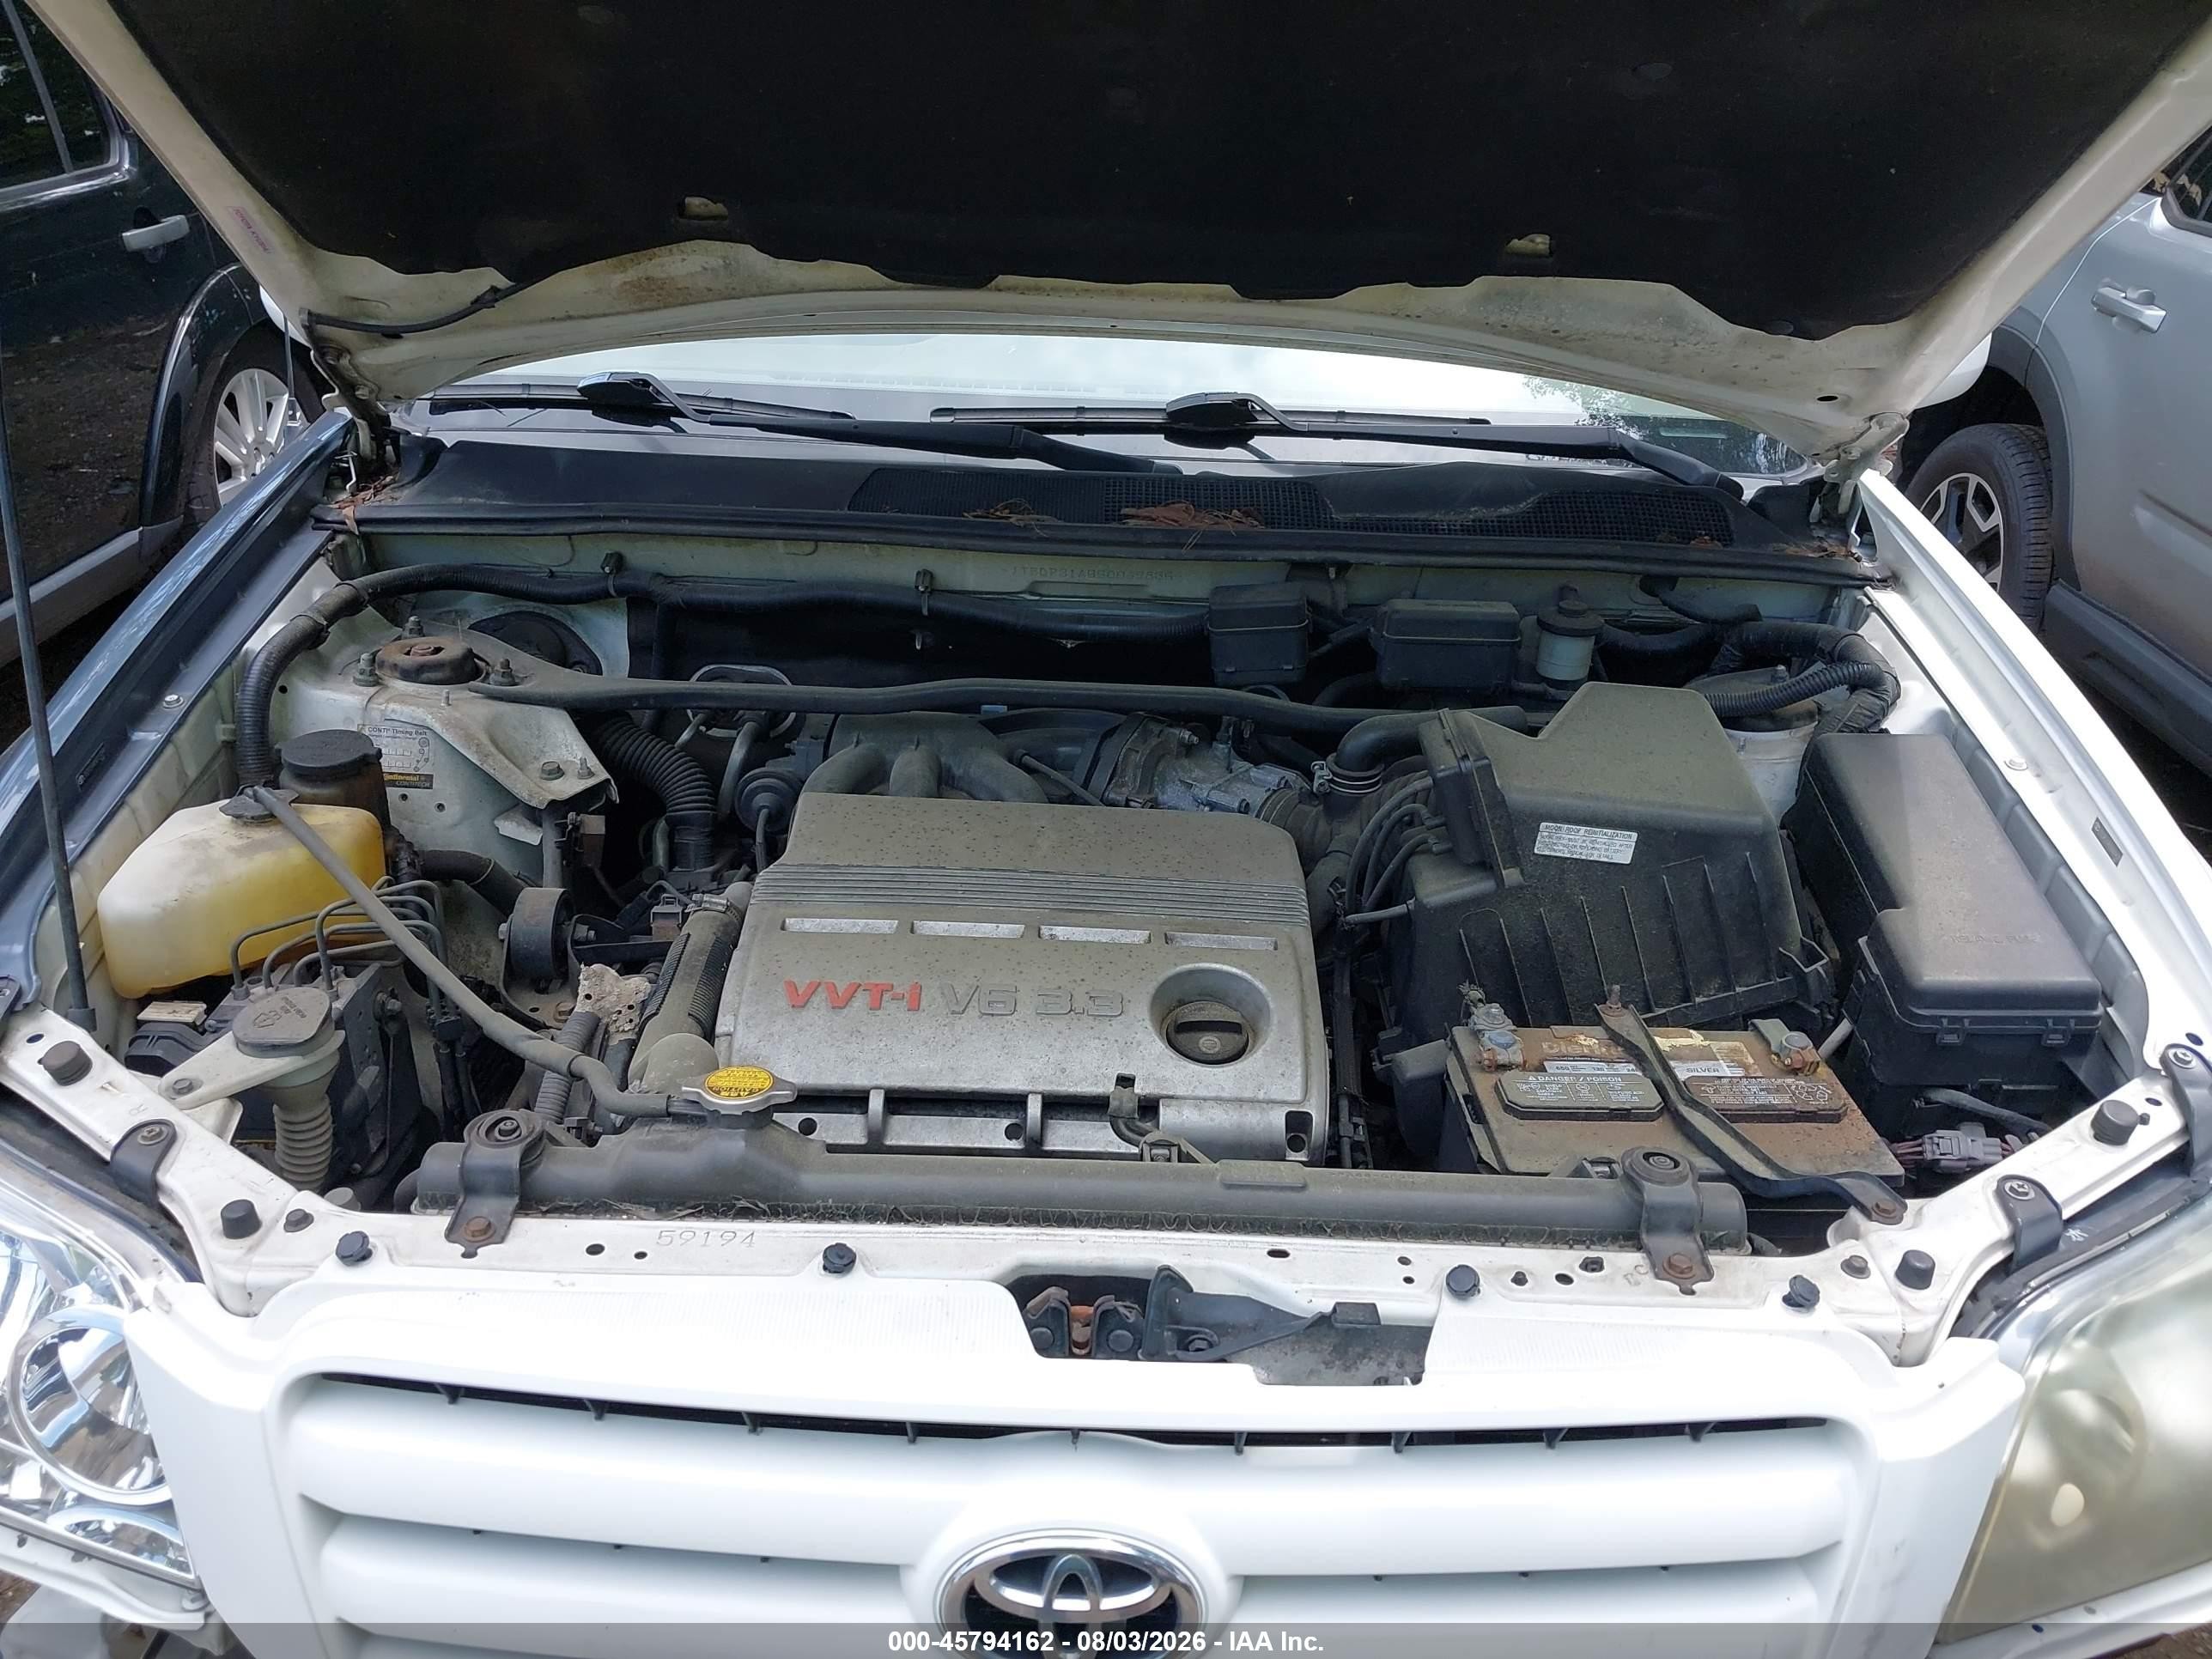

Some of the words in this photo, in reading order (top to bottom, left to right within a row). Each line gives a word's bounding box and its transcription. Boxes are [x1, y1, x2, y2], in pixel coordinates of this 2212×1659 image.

[1583, 829, 1632, 840] REINITIALIZATION
[940, 983, 1018, 1017] V6
[1036, 988, 1125, 1018] 3.3
[656, 1230, 756, 1248] 59194
